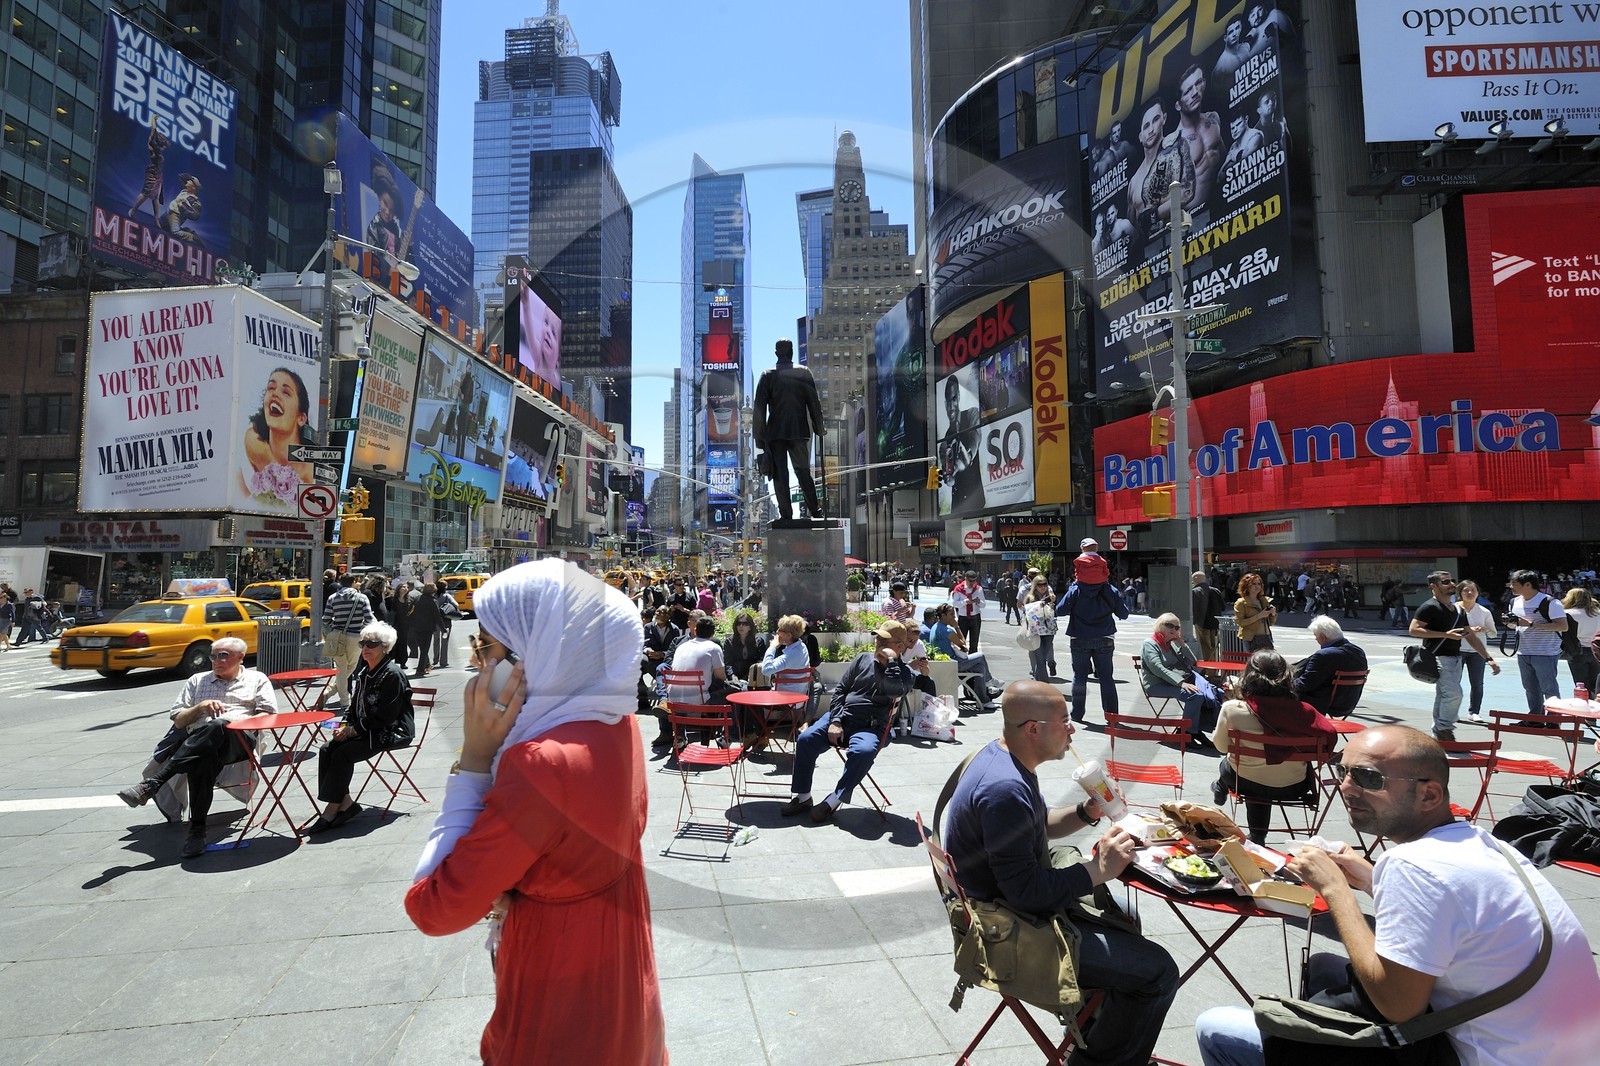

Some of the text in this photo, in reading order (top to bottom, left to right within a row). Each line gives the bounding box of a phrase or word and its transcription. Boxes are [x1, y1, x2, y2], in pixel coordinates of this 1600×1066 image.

[1402, 0, 1564, 37] opponent
[112, 16, 235, 109] WINNER!
[1235, 46, 1271, 84] MIR VS
[117, 42, 229, 120] 2010 TONY AWARD
[1230, 55, 1277, 101] NELSON
[1482, 80, 1519, 97] Pass
[1525, 79, 1538, 96] It
[115, 60, 228, 147] BEST
[1460, 109, 1543, 123] VALUES.COM
[113, 92, 226, 169] MUSICAL
[1091, 158, 1128, 195] RAMPAGE
[1222, 150, 1285, 198] SANTIAGO
[1226, 141, 1278, 182] STANN VS
[1099, 171, 1128, 200] HAMILL
[963, 211, 1065, 256] driving emotion
[1113, 268, 1134, 284] WORLD
[1186, 200, 1255, 242] CHAMPIONSHIP
[1094, 239, 1122, 265] STRUVE
[1096, 246, 1128, 276] BROWNE
[1543, 255, 1579, 268] Text
[1100, 266, 1152, 310] EDGAR
[1151, 258, 1168, 278] VS
[1192, 263, 1232, 293] MAY
[1239, 247, 1268, 272] 28
[1545, 272, 1562, 283] to
[1547, 286, 1570, 298] for
[100, 300, 214, 342] YOU ALREADY
[1104, 325, 1131, 348] LIVE
[1133, 318, 1155, 334] ON
[1191, 306, 1228, 330] BROADWAY
[132, 333, 185, 365] KNOW
[245, 315, 297, 355] MAMMA
[373, 331, 417, 366] YOU'VE MADE
[941, 301, 1016, 373] Kodak
[1196, 341, 1201, 350] W
[1204, 341, 1213, 351] 46
[370, 345, 379, 359] IT
[99, 354, 224, 398] YOU'RE GONNA
[368, 360, 402, 386] BUT WILL
[127, 385, 199, 421] LOVE IT!
[365, 388, 400, 414] TO RETIRE
[368, 374, 410, 403] YOU BE ABLE
[1034, 335, 1066, 446] Kodak
[336, 420, 341, 429] W
[343, 420, 351, 429] 46
[361, 417, 370, 426] ASK
[371, 420, 383, 430] TEAM
[363, 402, 406, 429] ANYWHERE?
[98, 429, 214, 476] MAMMA MIA!
[367, 441, 390, 452] Ameritrade
[986, 421, 1025, 472] SO
[1197, 428, 1243, 477] of
[1248, 399, 1561, 470] America
[322, 451, 338, 459] WAY
[148, 468, 168, 476] MUSICAL
[317, 468, 325, 476] ONE
[710, 474, 735, 483] MUCH
[710, 484, 736, 494] MORE!
[60, 521, 162, 534] DIGITAL
[500, 506, 538, 533] FOREVER
[1255, 520, 1293, 537] Marriott
[114, 534, 180, 544] COMPUTERS
